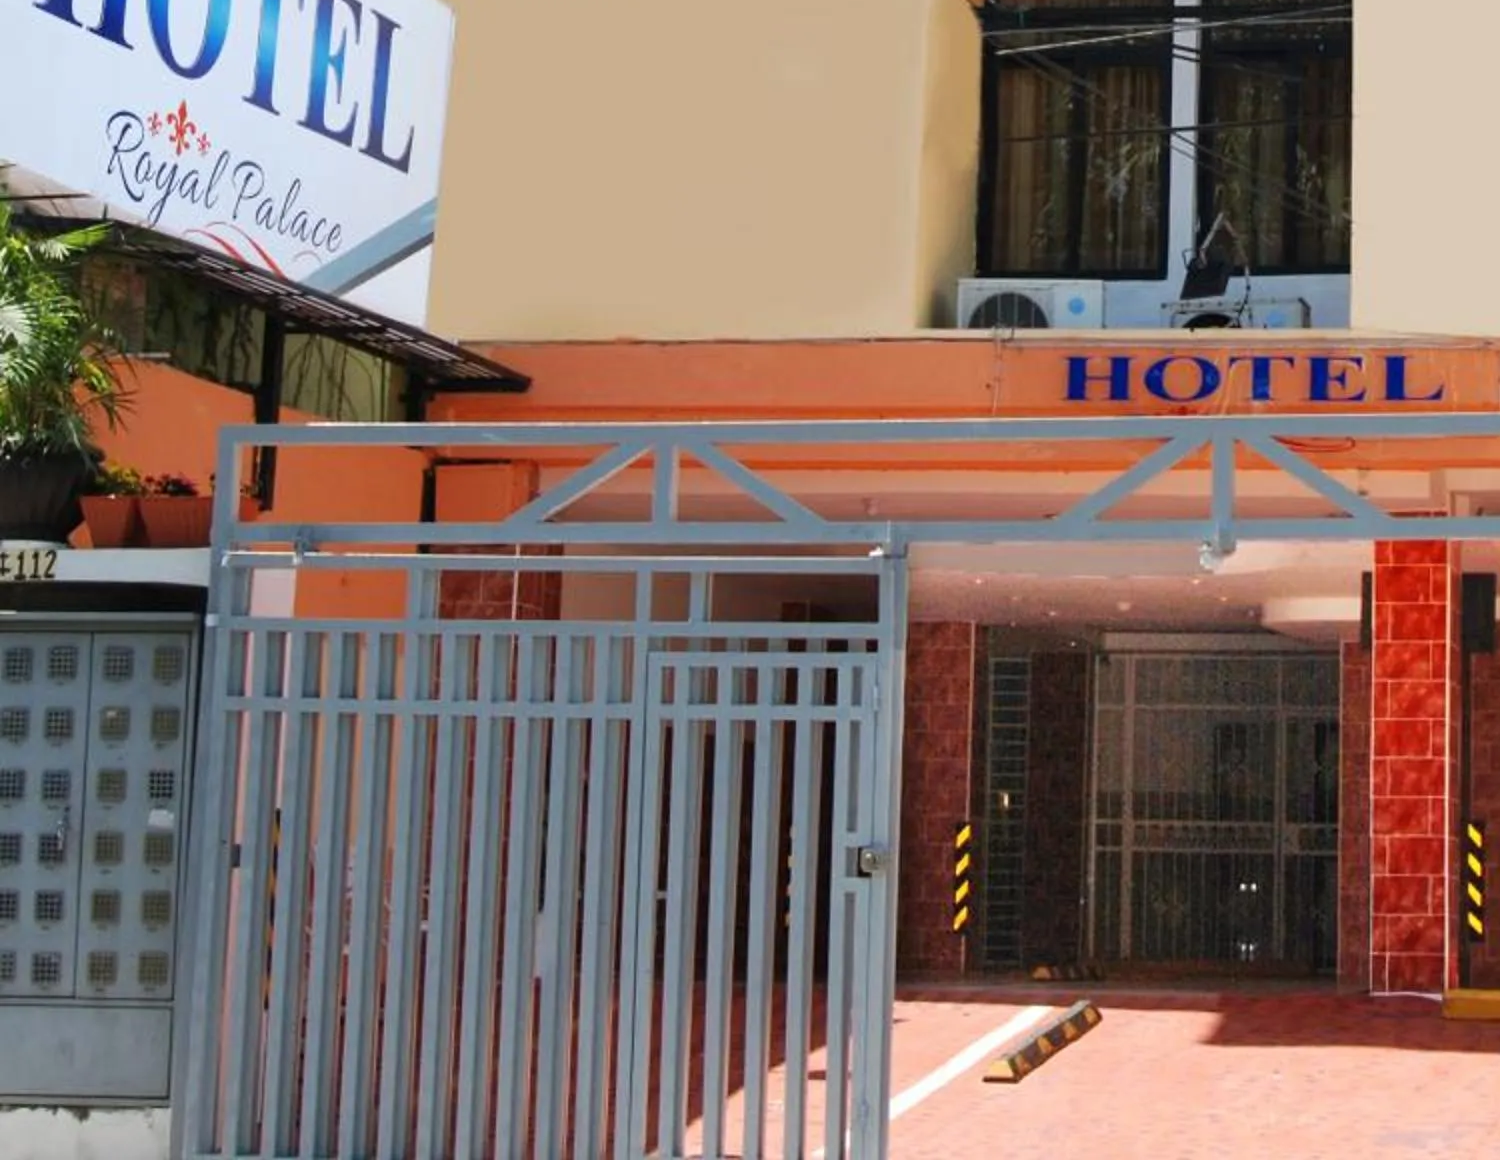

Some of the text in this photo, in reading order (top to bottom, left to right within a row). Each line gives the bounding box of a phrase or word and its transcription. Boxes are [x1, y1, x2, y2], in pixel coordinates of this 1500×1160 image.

[105, 110, 344, 252] Royal Palace
[1063, 355, 1445, 402] HOTEL
